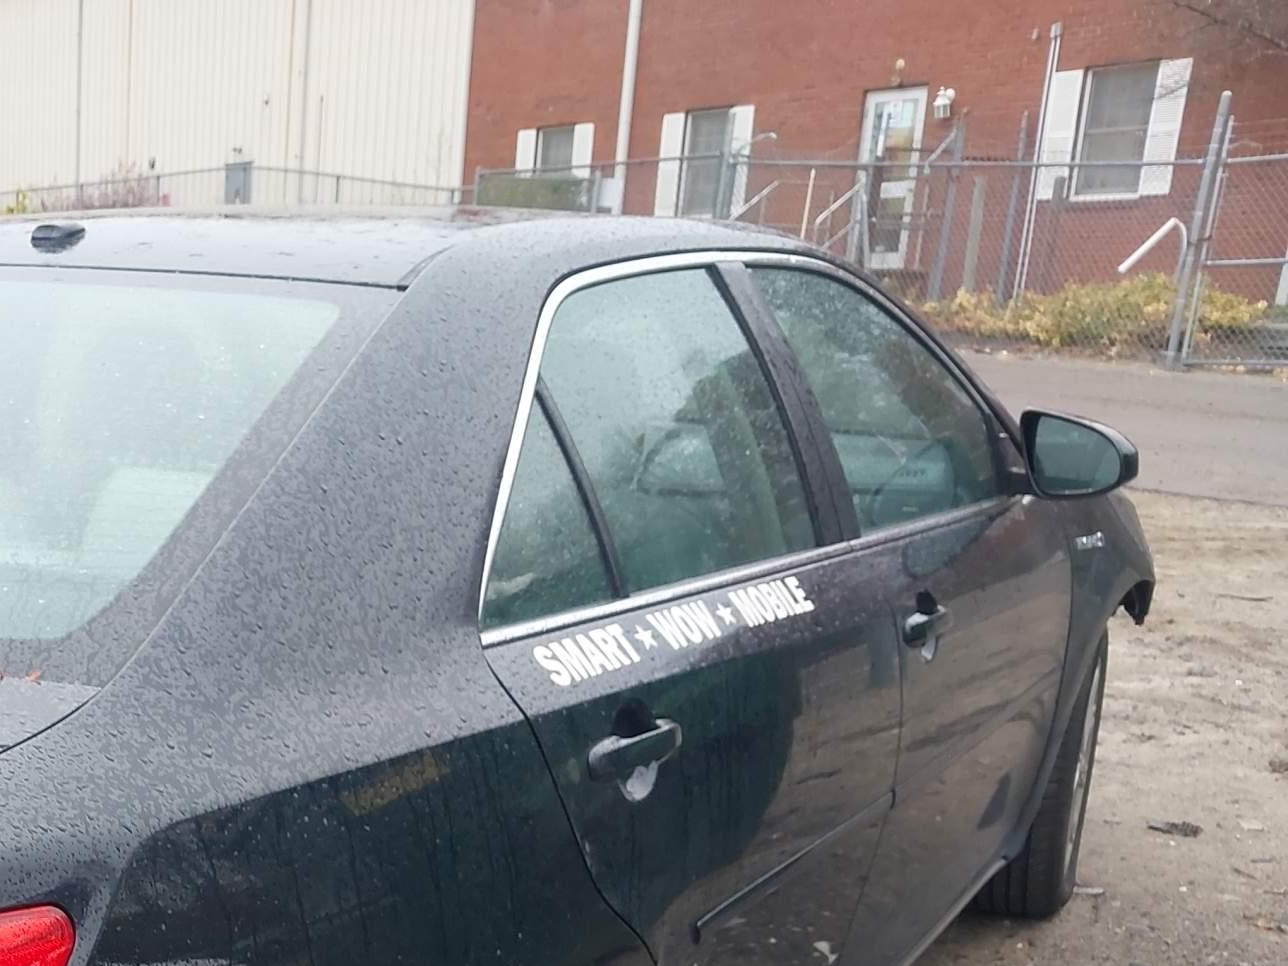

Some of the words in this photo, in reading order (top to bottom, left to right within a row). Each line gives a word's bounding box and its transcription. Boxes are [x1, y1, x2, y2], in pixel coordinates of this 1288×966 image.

[533, 623, 641, 687] SMART
[645, 600, 722, 651] WOW
[727, 576, 816, 628] MOBILE
